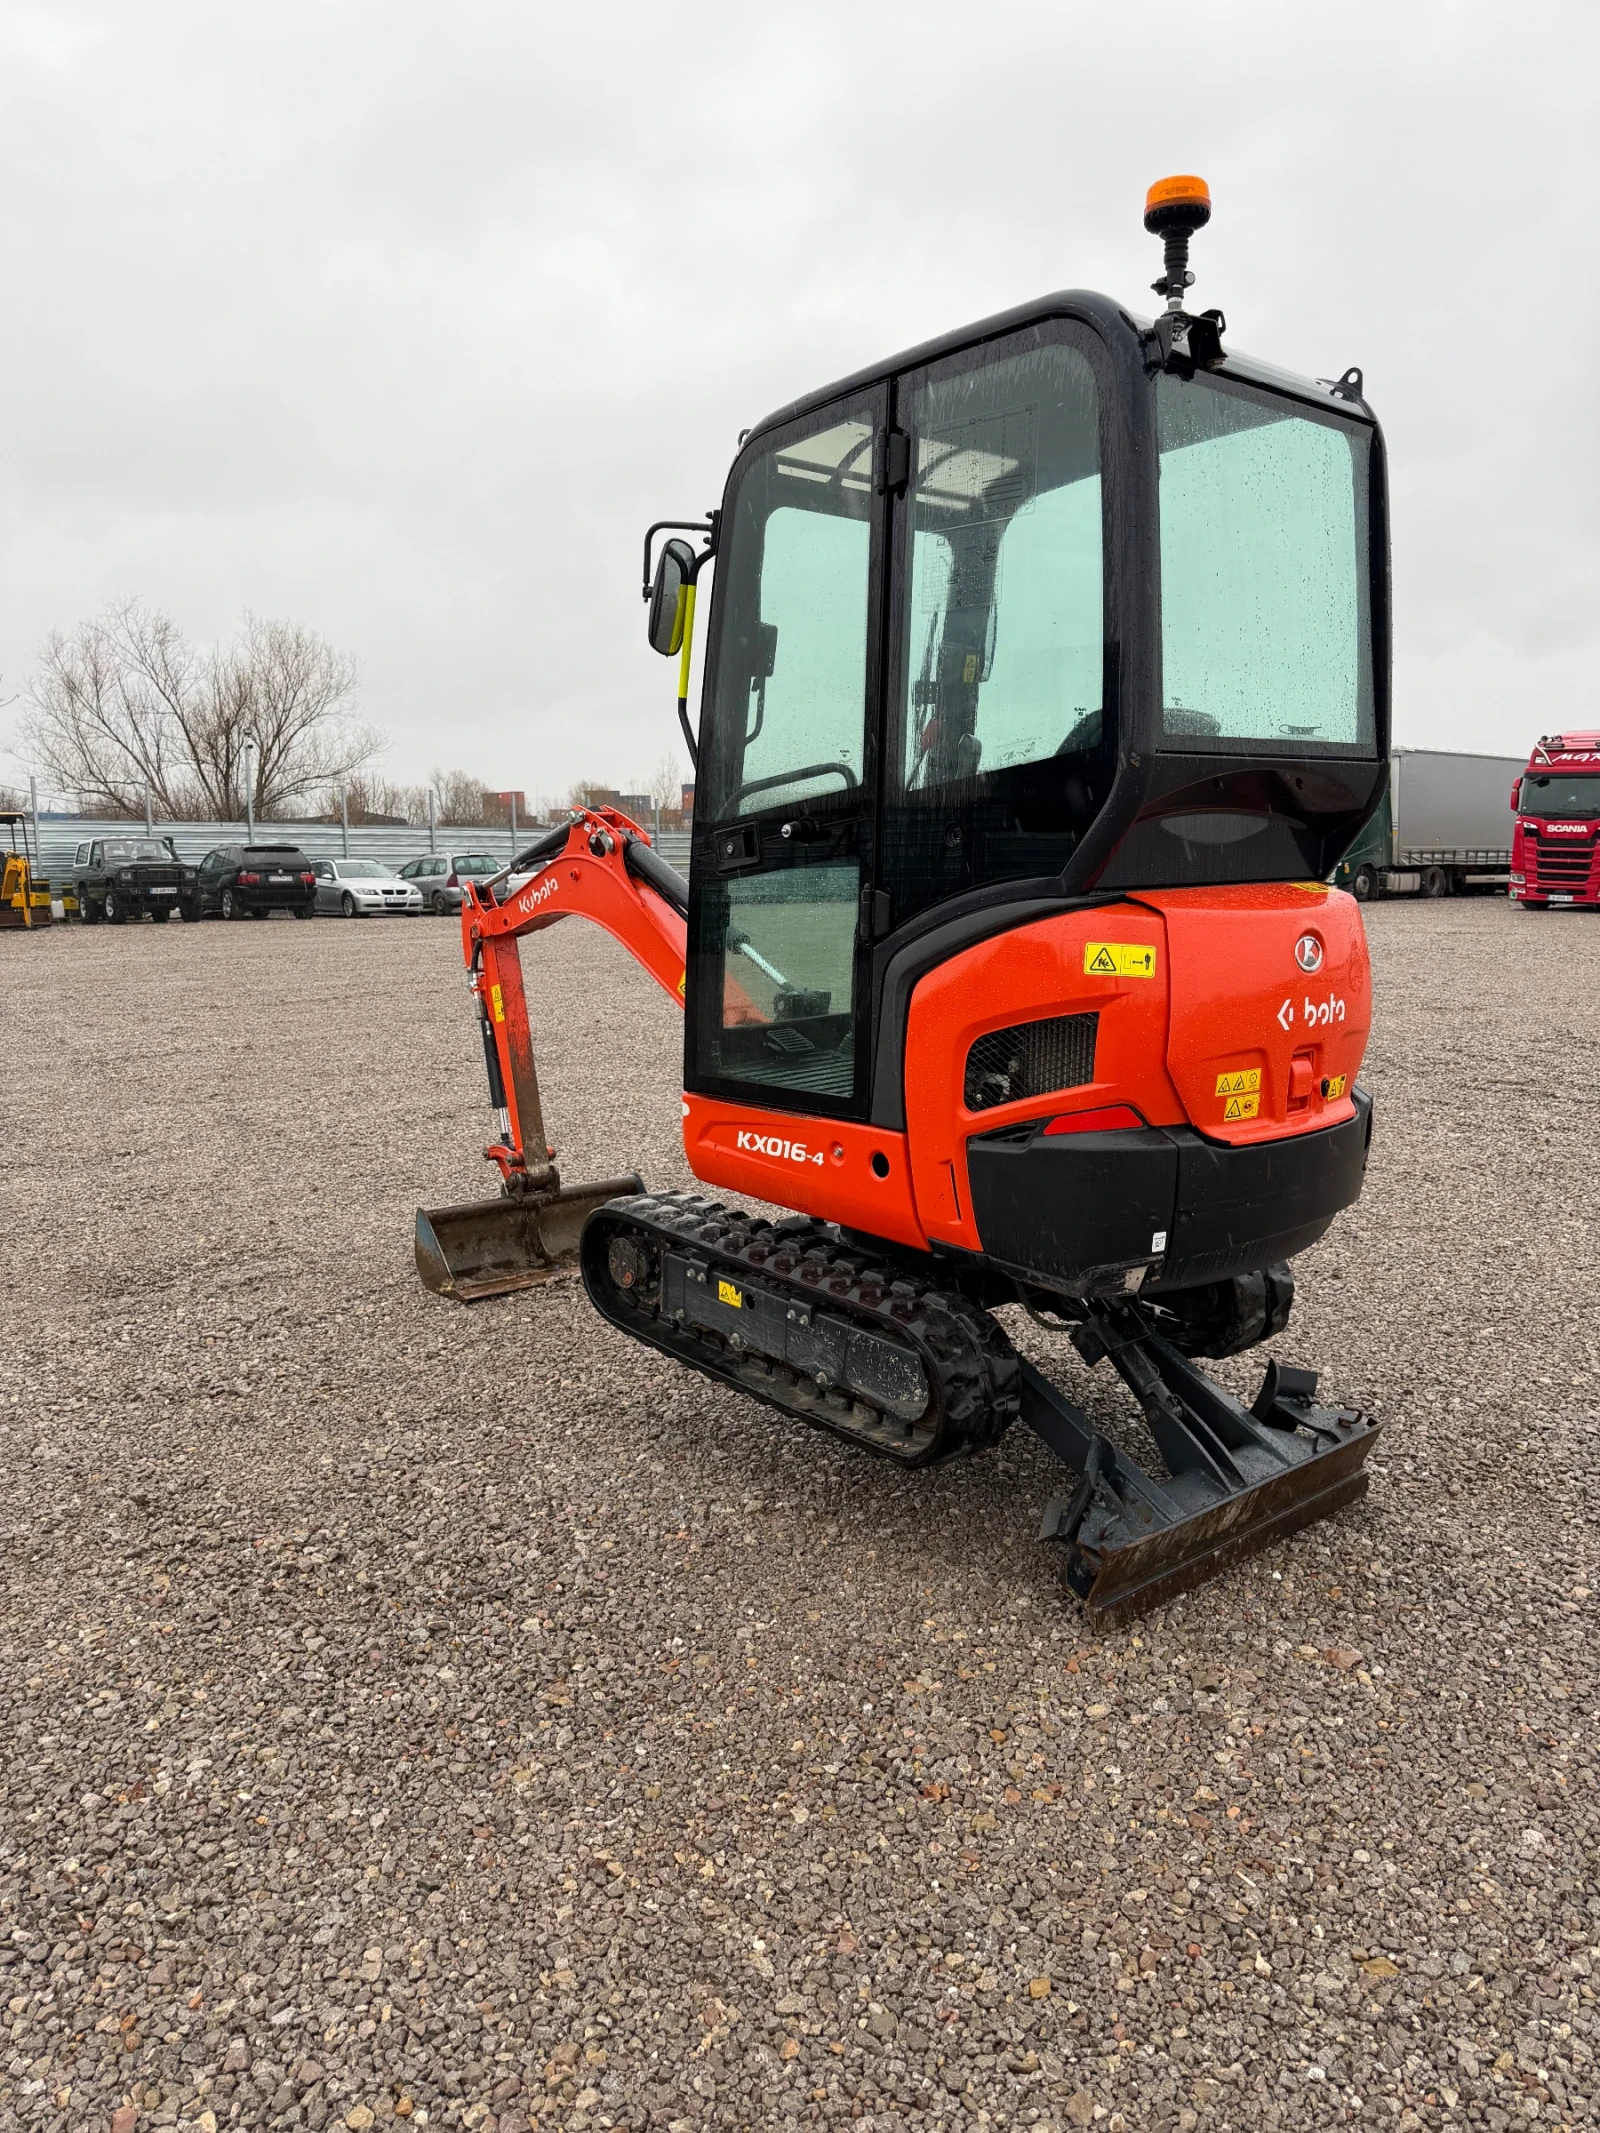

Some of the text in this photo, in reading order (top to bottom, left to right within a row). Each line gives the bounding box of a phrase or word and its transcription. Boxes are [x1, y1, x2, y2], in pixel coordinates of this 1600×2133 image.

[1546, 824, 1588, 833] SCANIA
[518, 877, 559, 914] Kubota
[737, 1130, 824, 1166] KX016-4
